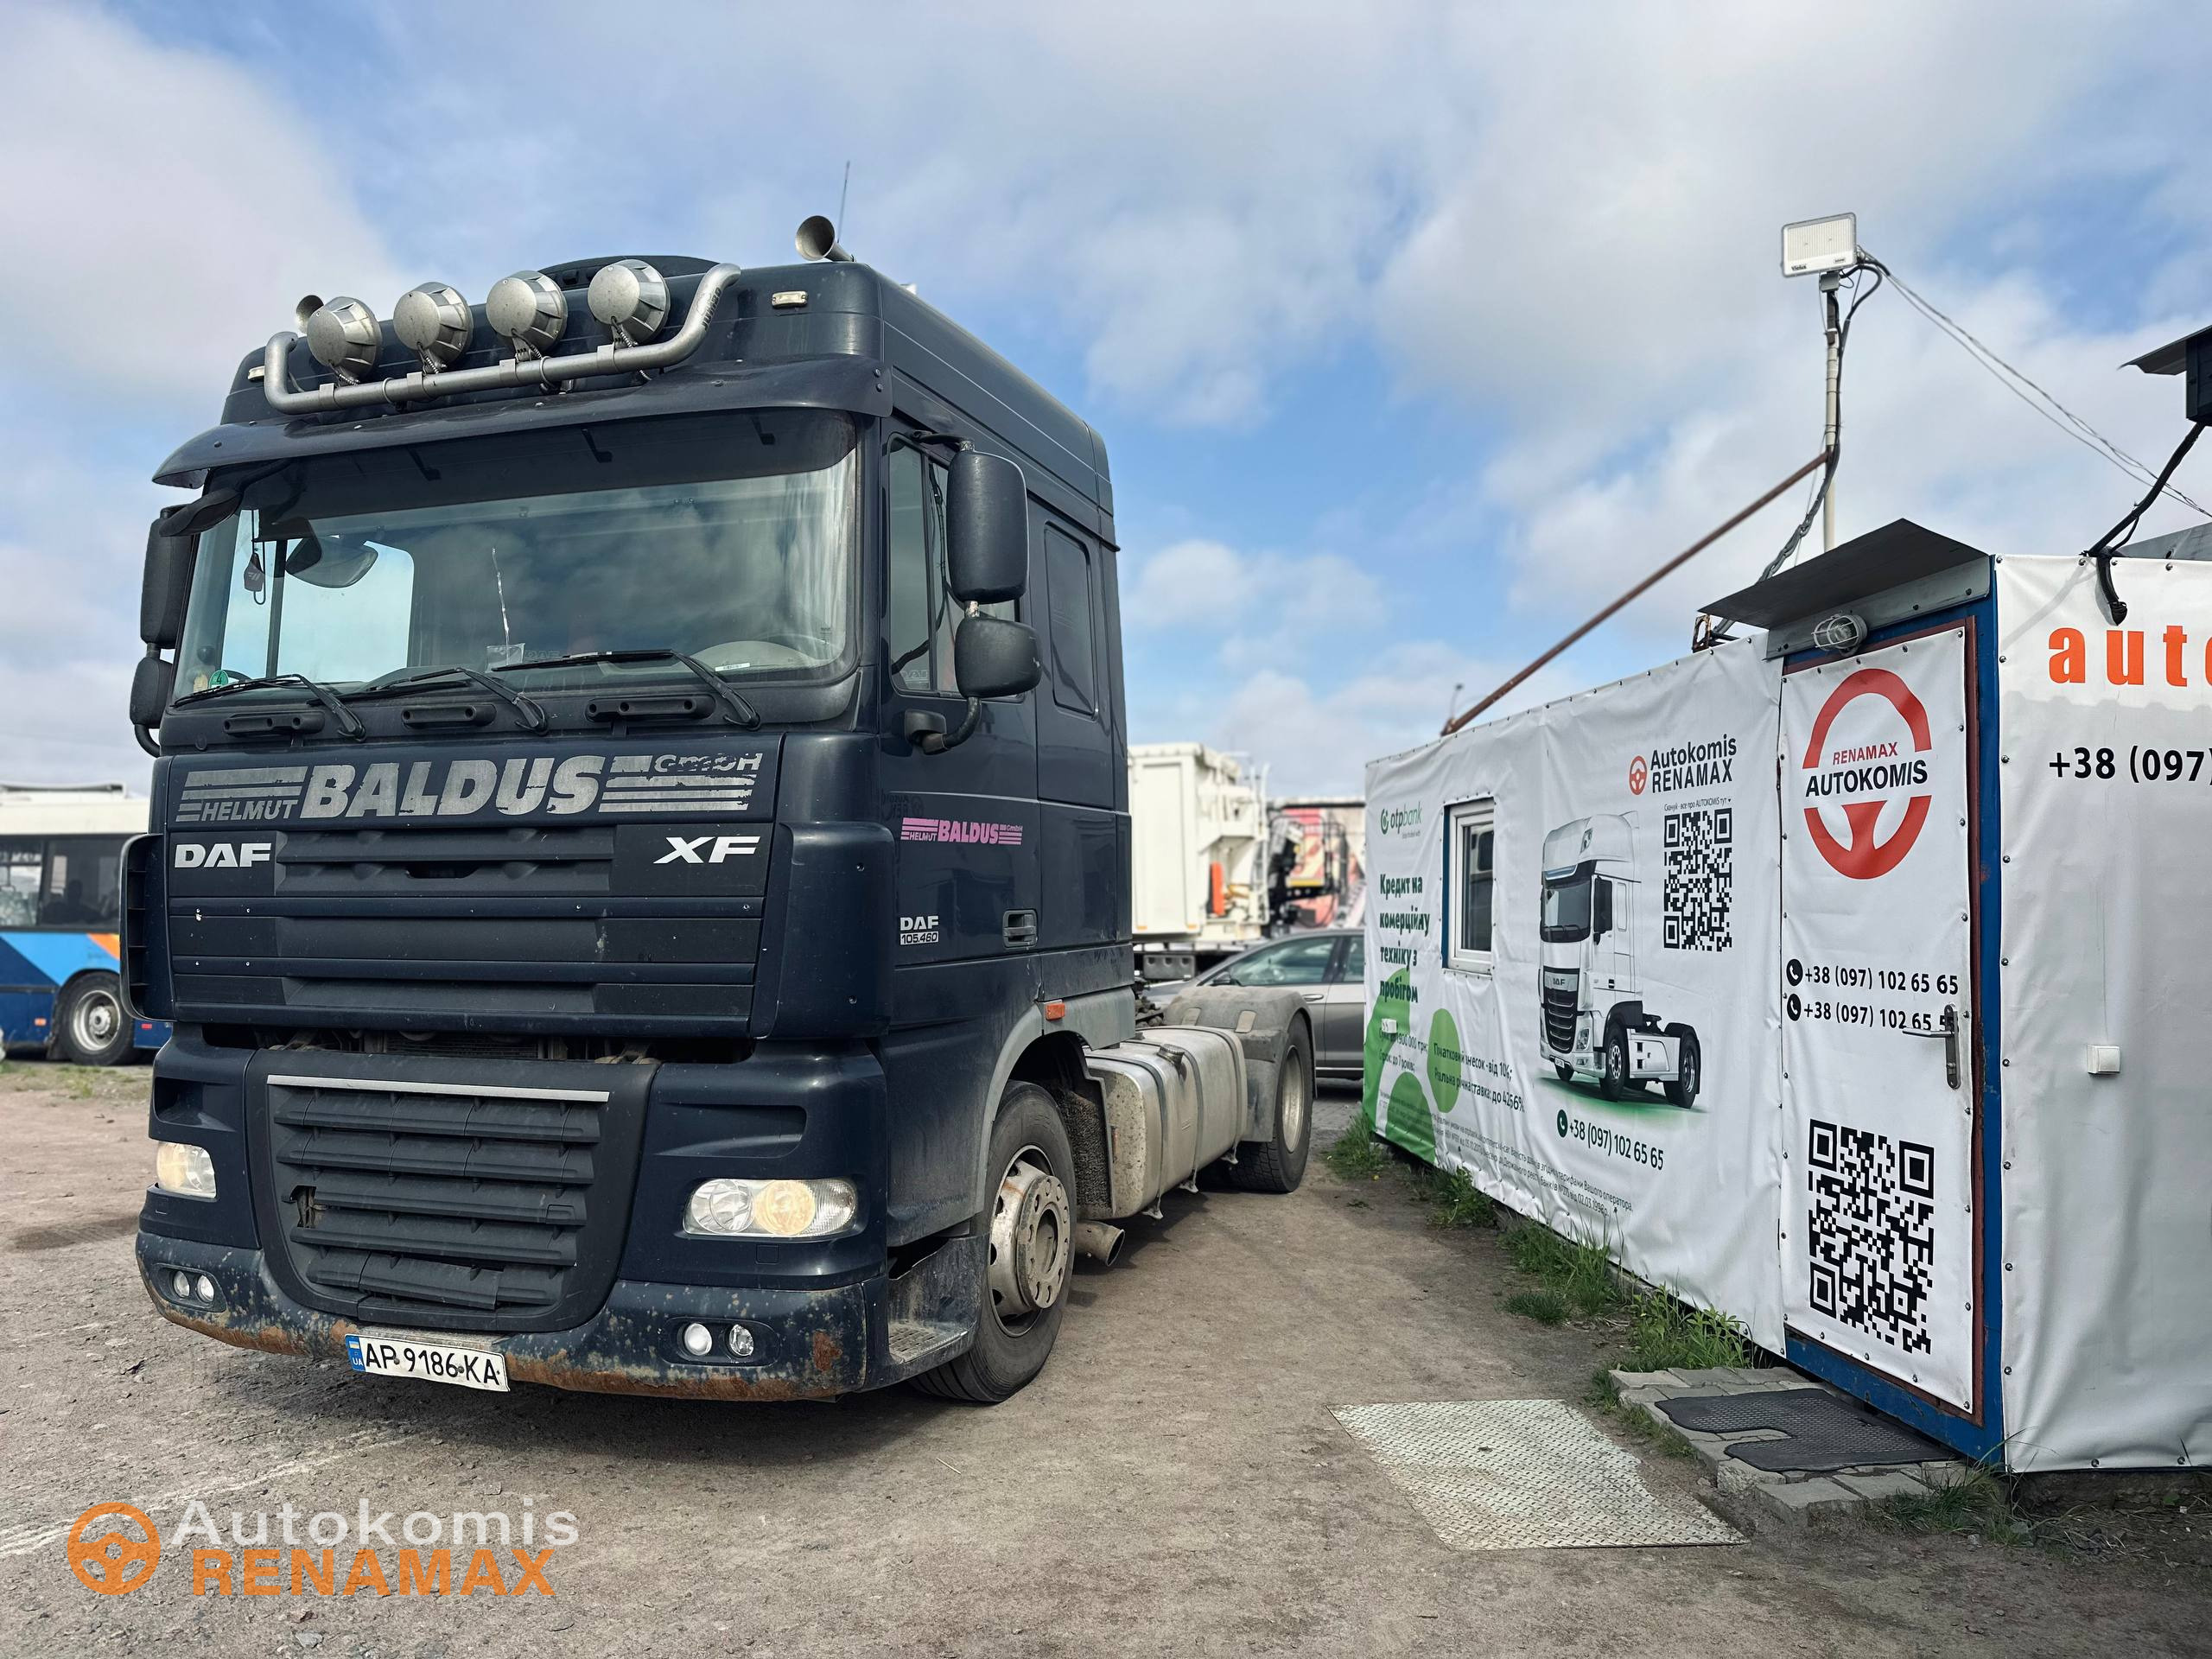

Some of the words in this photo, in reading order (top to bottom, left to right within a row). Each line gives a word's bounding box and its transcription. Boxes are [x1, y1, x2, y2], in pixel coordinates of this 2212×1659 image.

[1650, 734, 1737, 771] Autokomis
[1833, 741, 1898, 766] RENAMAX
[2049, 747, 2116, 779] +38
[201, 800, 299, 822] HELMUT
[300, 755, 606, 819] BALDUS
[1652, 759, 1732, 793] RENAMAX
[1805, 760, 1928, 798] AUTOKOMIS
[909, 832, 938, 842] HELMUT
[938, 819, 999, 844] BALDUS
[175, 842, 272, 868] DAF
[652, 836, 760, 864] XF
[1380, 874, 1410, 899] Кредит
[1412, 874, 1423, 894] на
[899, 915, 939, 931] DAF
[901, 932, 938, 944] 105.460
[1381, 940, 1411, 970] техніку
[1413, 950, 1418, 966] з
[1380, 976, 1419, 1003] пробігом
[1805, 965, 1830, 984] +38
[1835, 965, 1872, 989] (097)
[1878, 970, 1906, 991] 102
[1911, 973, 1929, 993] 65
[1936, 975, 1959, 995] 65
[1804, 1001, 1832, 1020] +38
[1836, 1002, 1873, 1027] (097)
[1879, 1008, 1906, 1029] 102
[1912, 1013, 1931, 1030] 65
[1492, 1091, 1502, 1104] до
[1570, 1119, 1586, 1141] +38
[1587, 1122, 1612, 1157] (097)
[1614, 1134, 1631, 1159] 102
[1634, 1141, 1647, 1164] 65
[1650, 1147, 1664, 1170] 65
[365, 1343, 397, 1369] AP
[404, 1348, 459, 1378] 9186
[464, 1355, 499, 1385] KA
